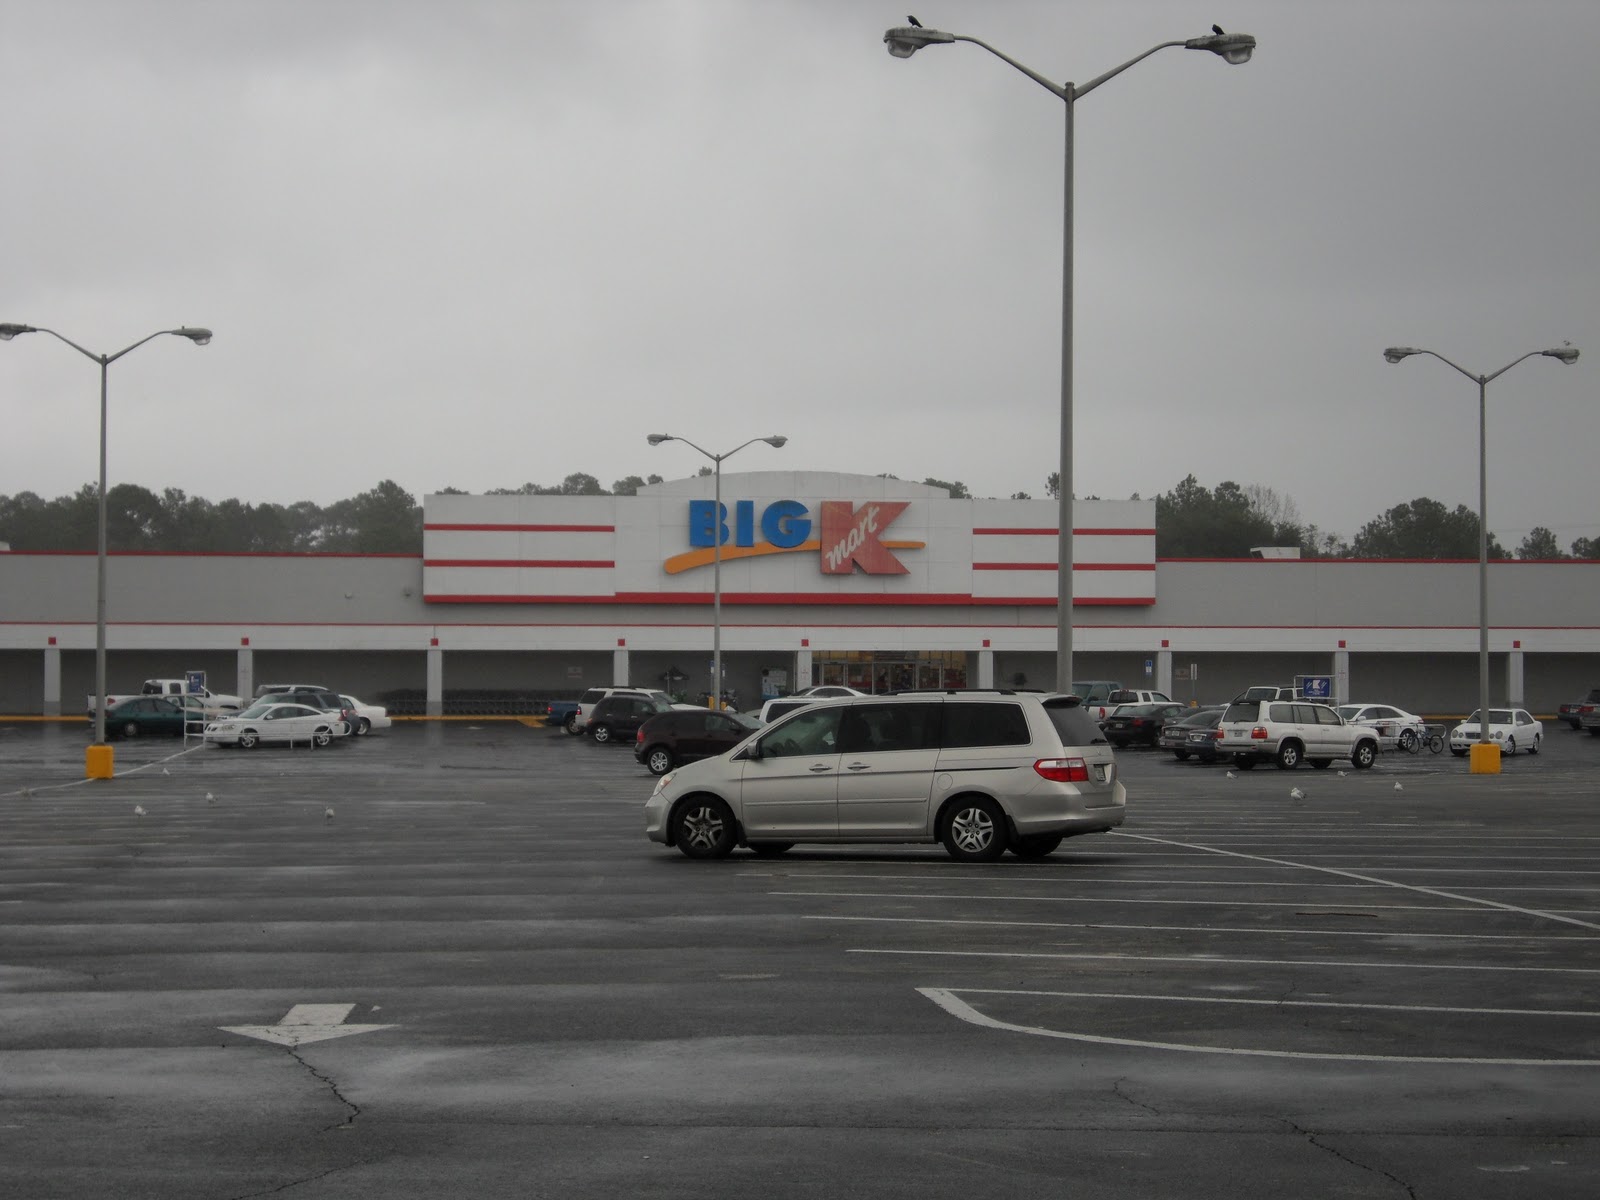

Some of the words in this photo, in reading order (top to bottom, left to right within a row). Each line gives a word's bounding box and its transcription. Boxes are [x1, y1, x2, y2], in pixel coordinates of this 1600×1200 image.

[689, 500, 812, 549] BIG
[820, 501, 912, 575] K
[825, 506, 880, 570] mart
